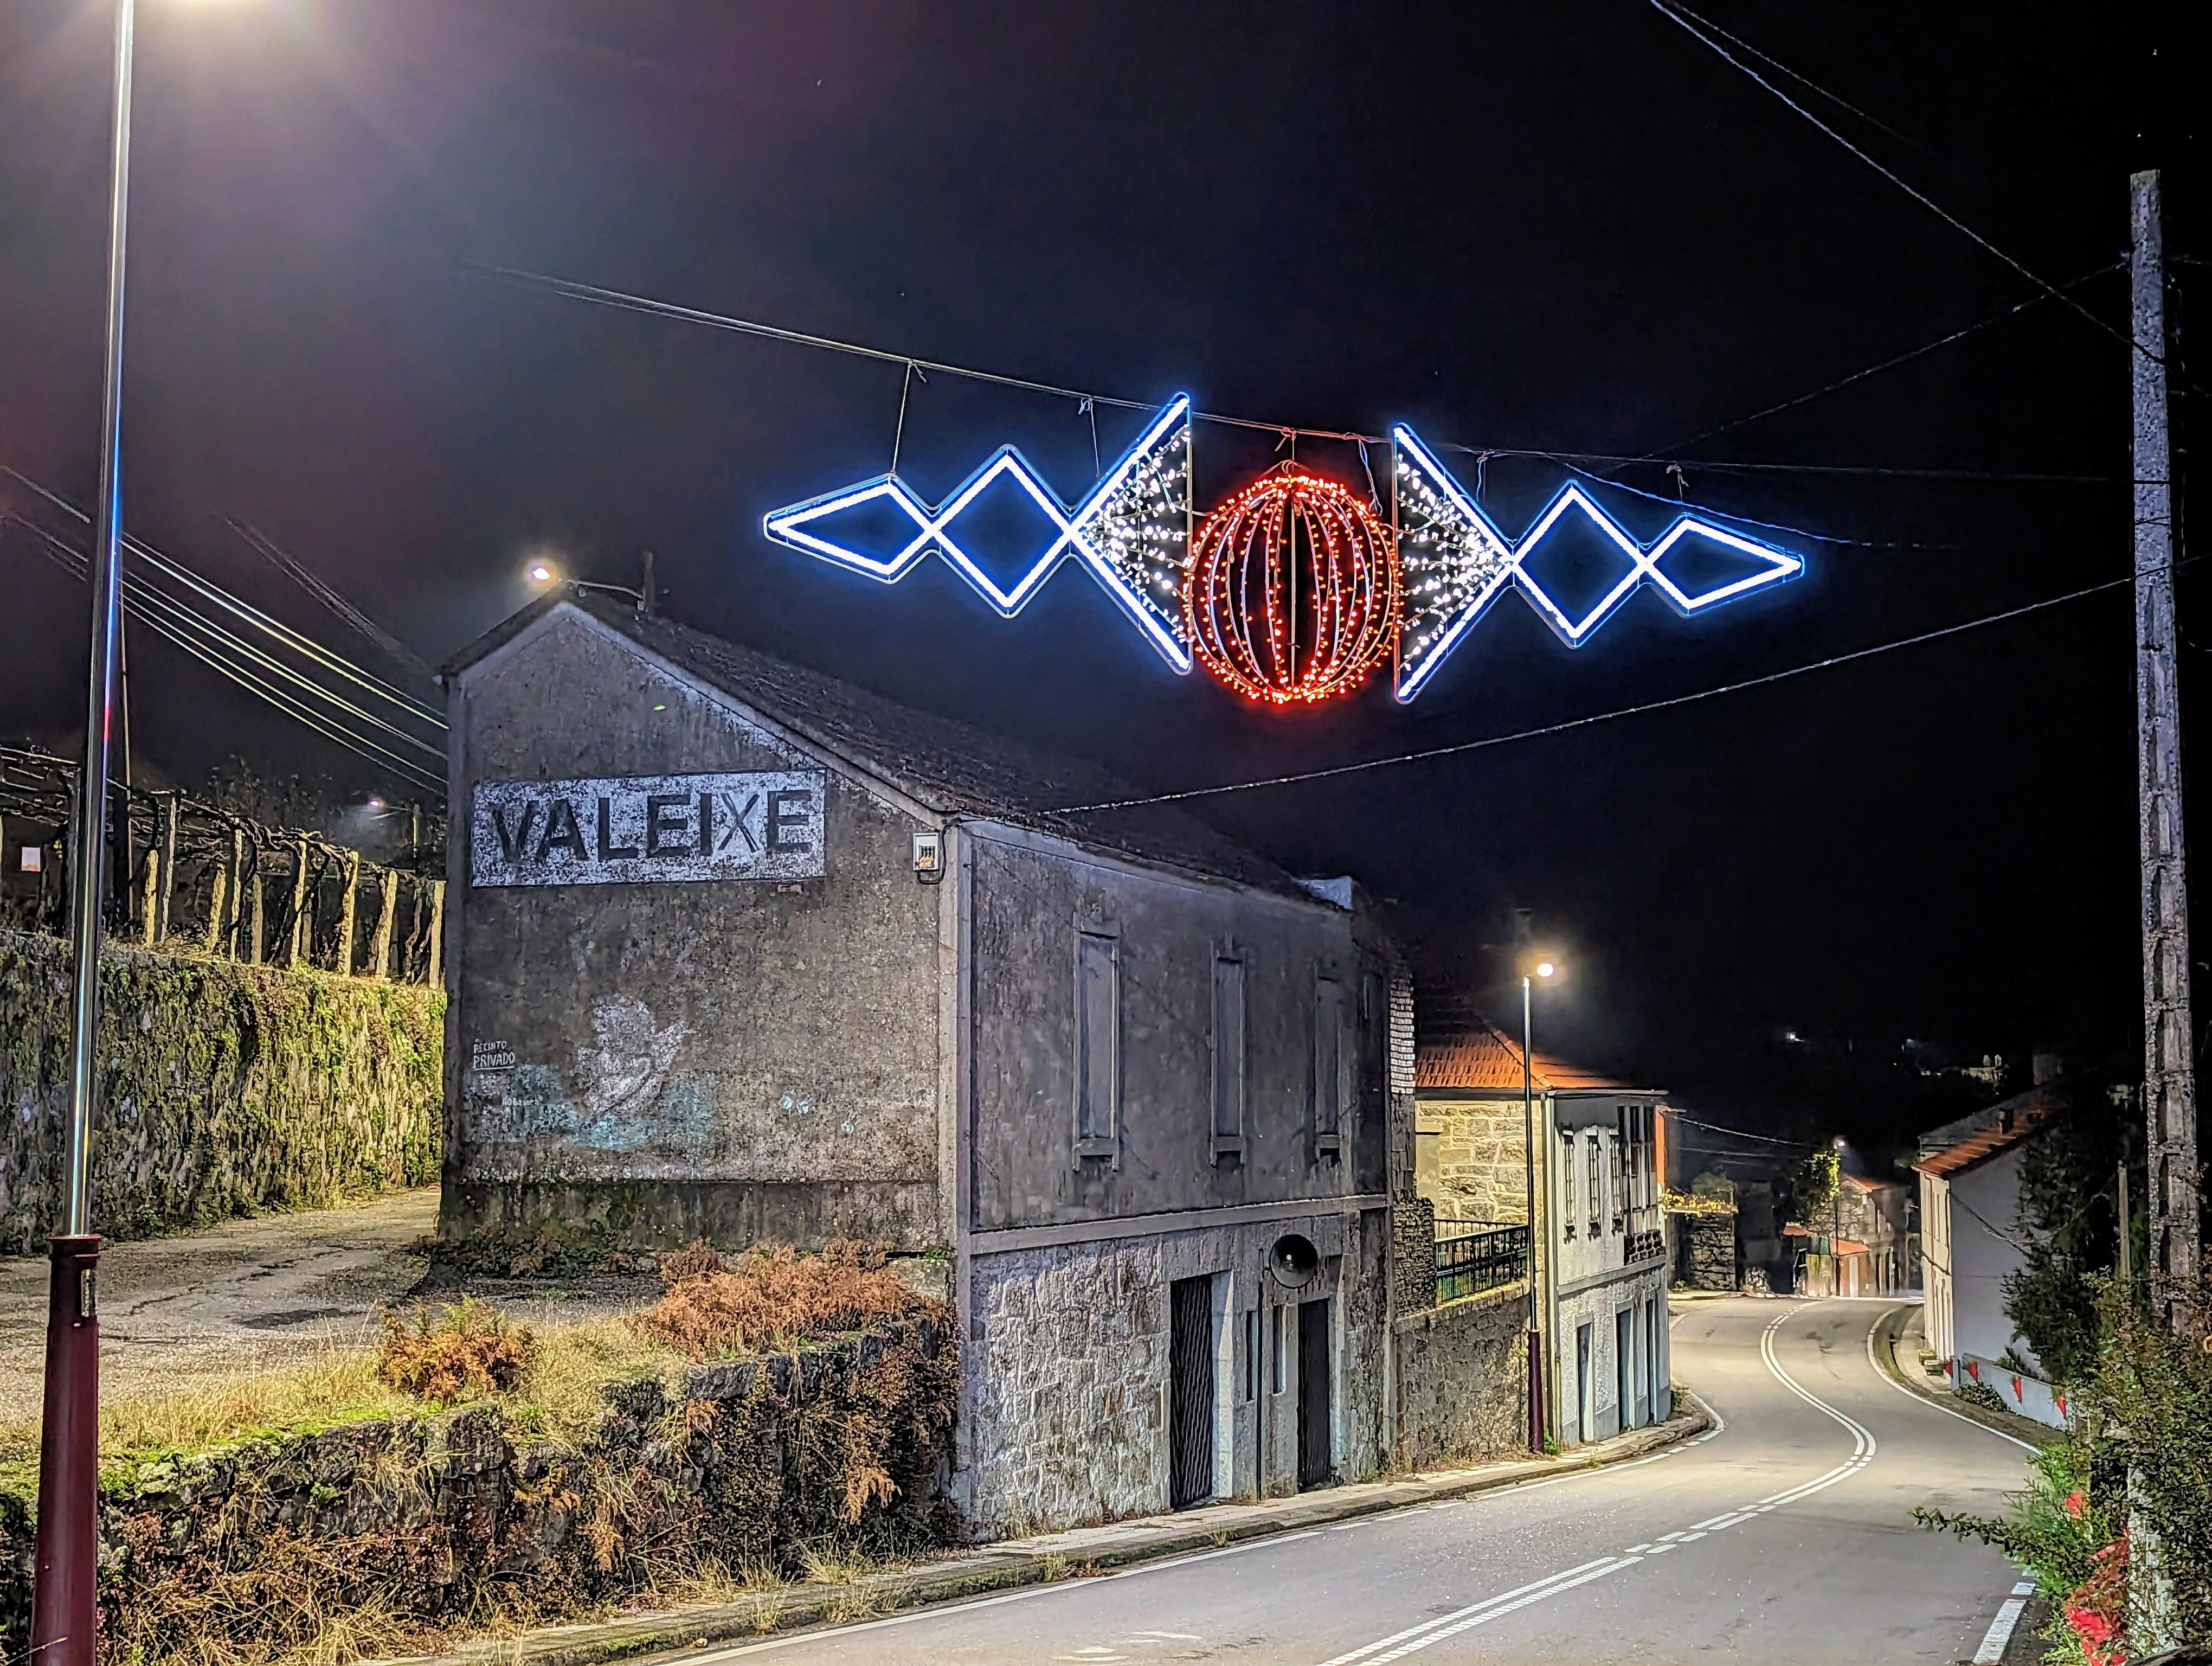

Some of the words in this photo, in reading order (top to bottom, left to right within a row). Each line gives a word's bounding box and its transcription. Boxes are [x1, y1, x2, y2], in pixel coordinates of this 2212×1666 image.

[490, 789, 812, 863] VALEIXE
[473, 1040, 507, 1054] RECINTO
[473, 1052, 516, 1069] PRIVADO
